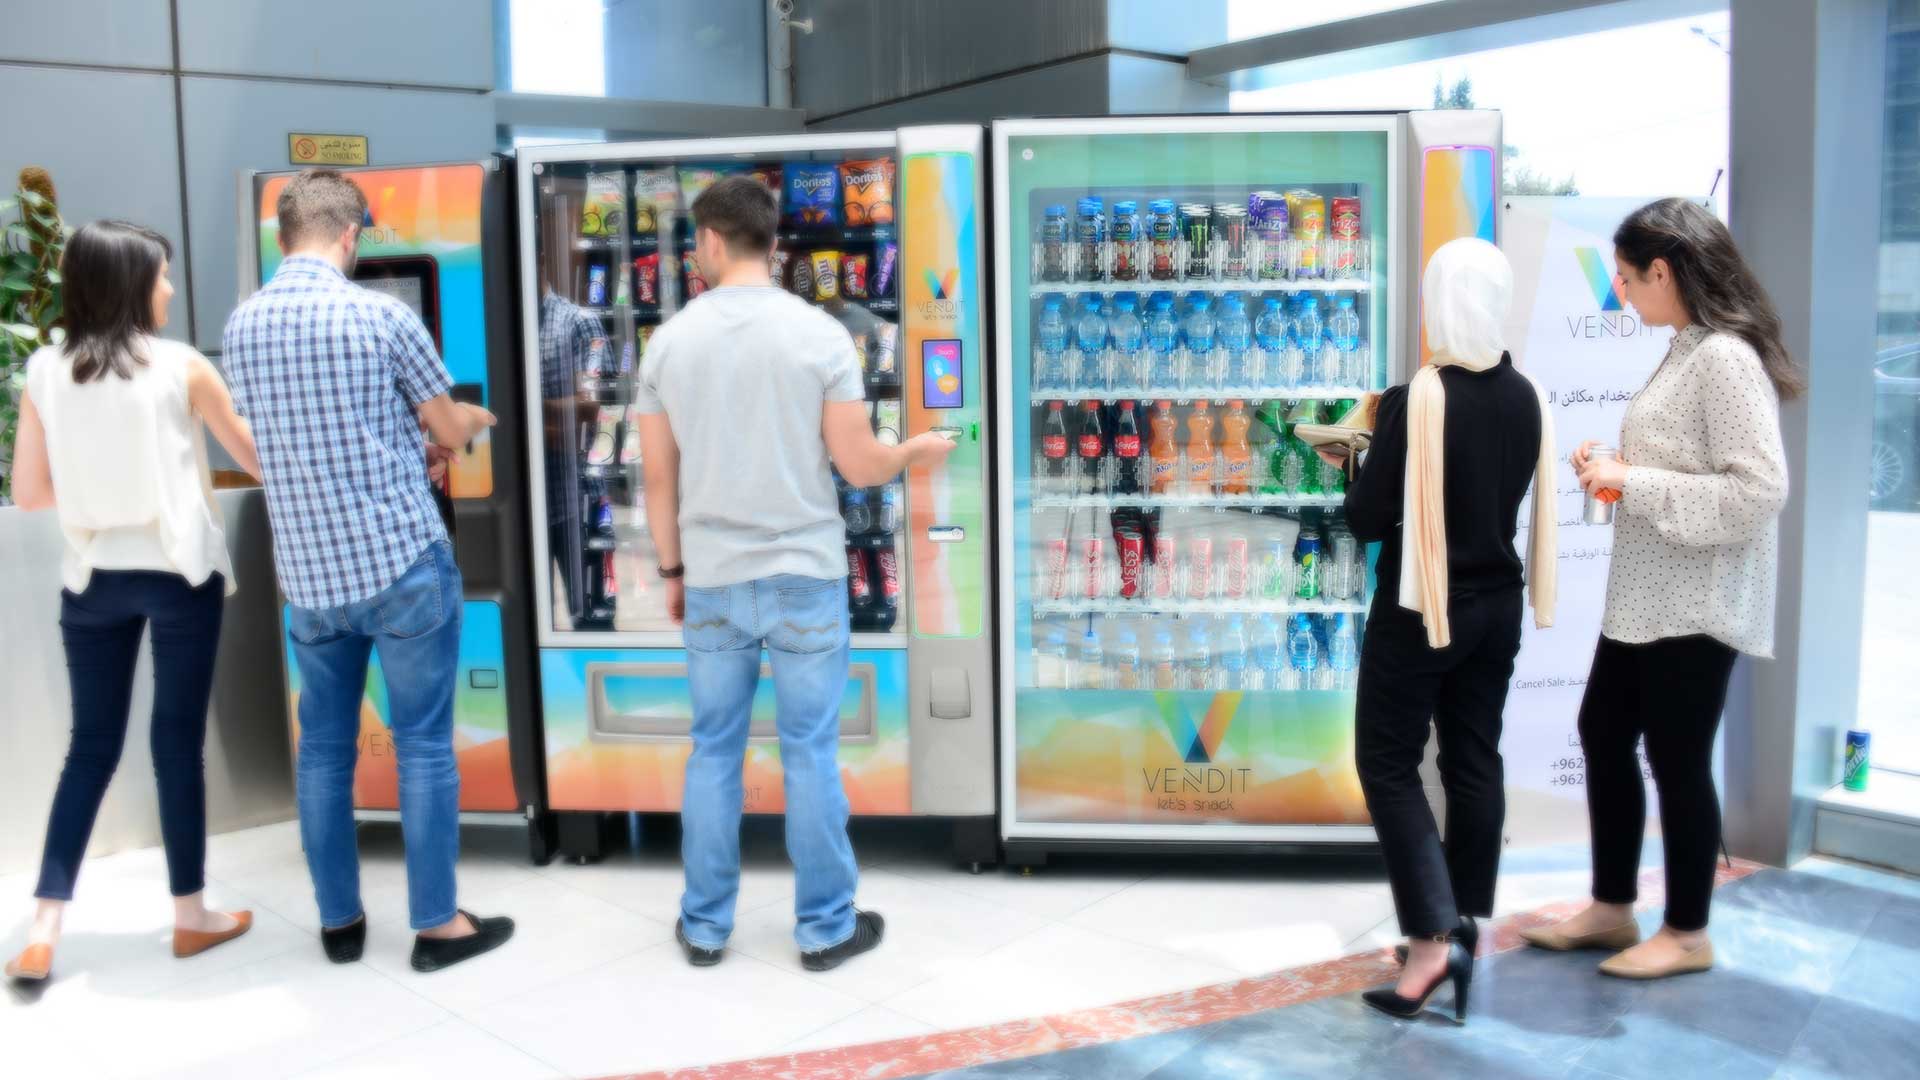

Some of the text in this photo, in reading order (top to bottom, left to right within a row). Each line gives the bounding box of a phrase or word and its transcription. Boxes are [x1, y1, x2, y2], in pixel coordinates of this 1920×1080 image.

[321, 151, 362, 160] NO SMOKING
[794, 176, 832, 189] Doritos
[845, 172, 884, 185] Doritos
[360, 228, 400, 245] NDIT
[917, 300, 965, 313] VENDIT
[1547, 677, 1566, 687] Sale
[1551, 757, 1584, 770] +962
[1142, 767, 1252, 794] VENDIT
[1551, 773, 1584, 786] +962
[1157, 797, 1235, 811] let's snack
